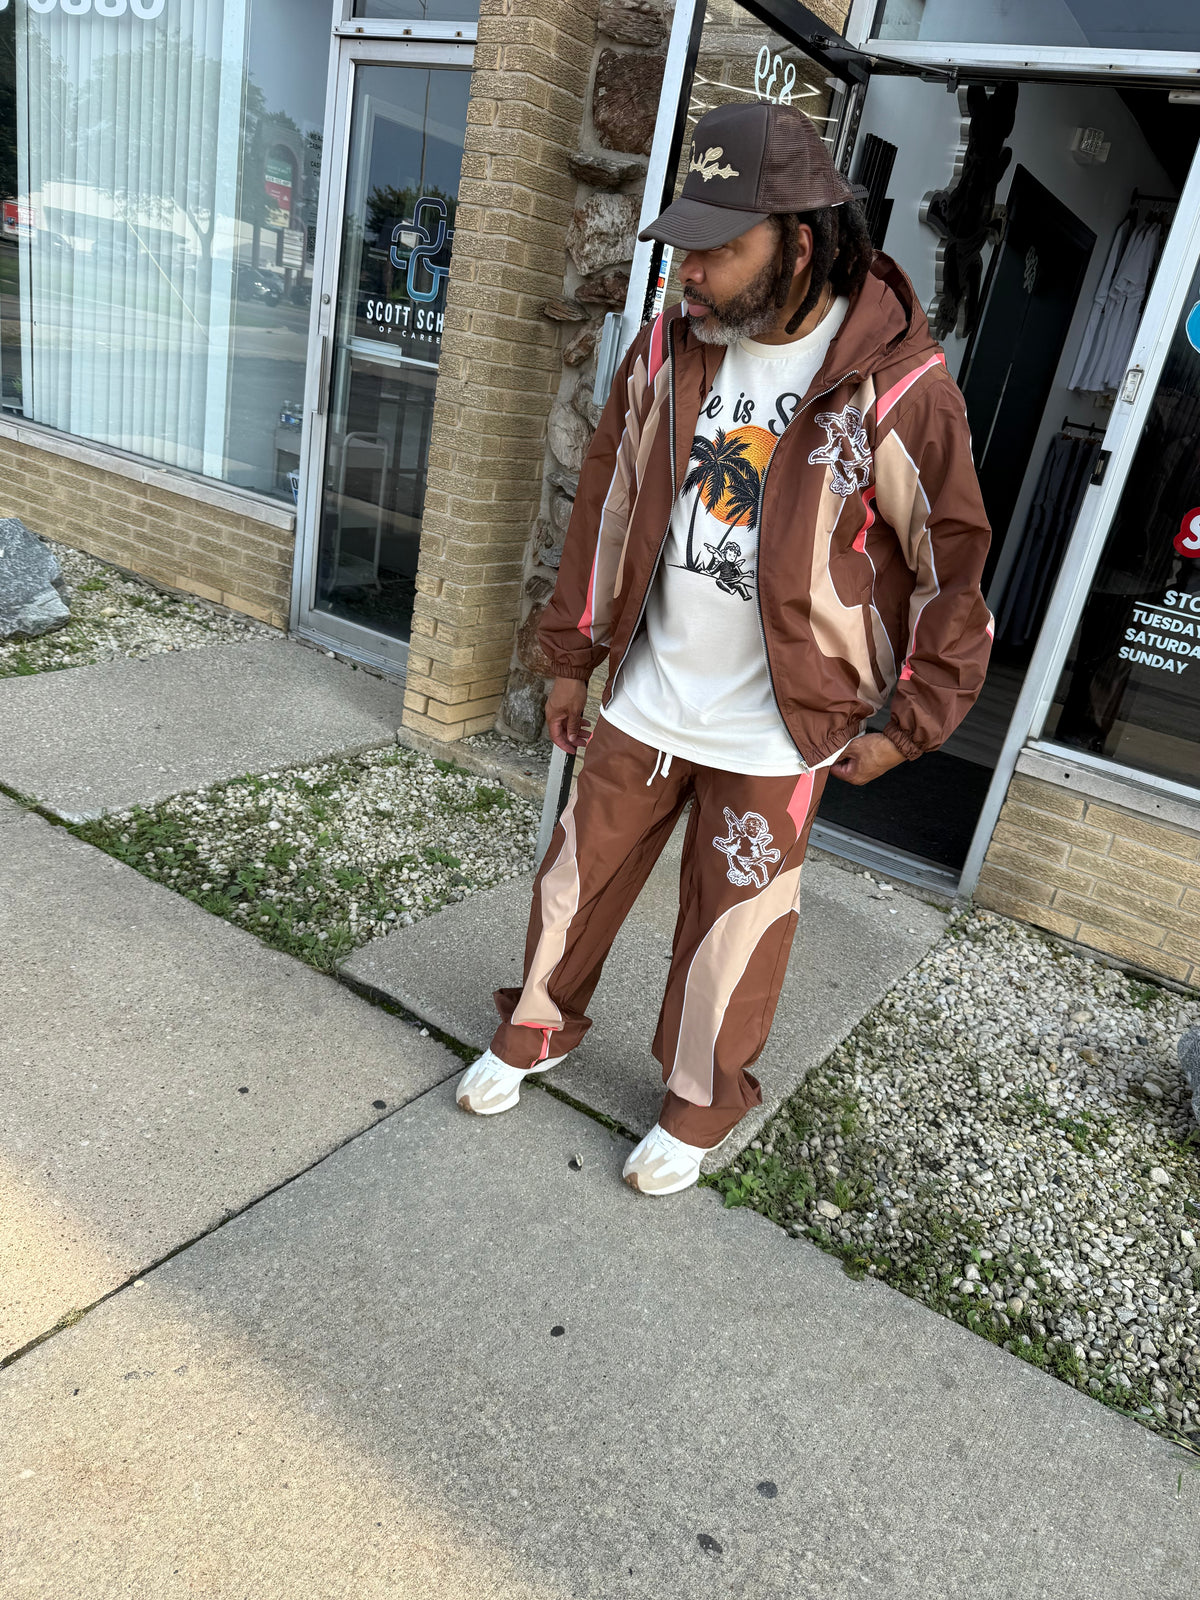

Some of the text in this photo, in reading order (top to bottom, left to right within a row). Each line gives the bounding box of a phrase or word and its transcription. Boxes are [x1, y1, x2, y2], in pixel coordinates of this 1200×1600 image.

[366, 299, 445, 333] SCOTT SCH
[378, 325, 392, 335] OF
[732, 392, 755, 424] is
[1118, 646, 1190, 675] SUNDAY
